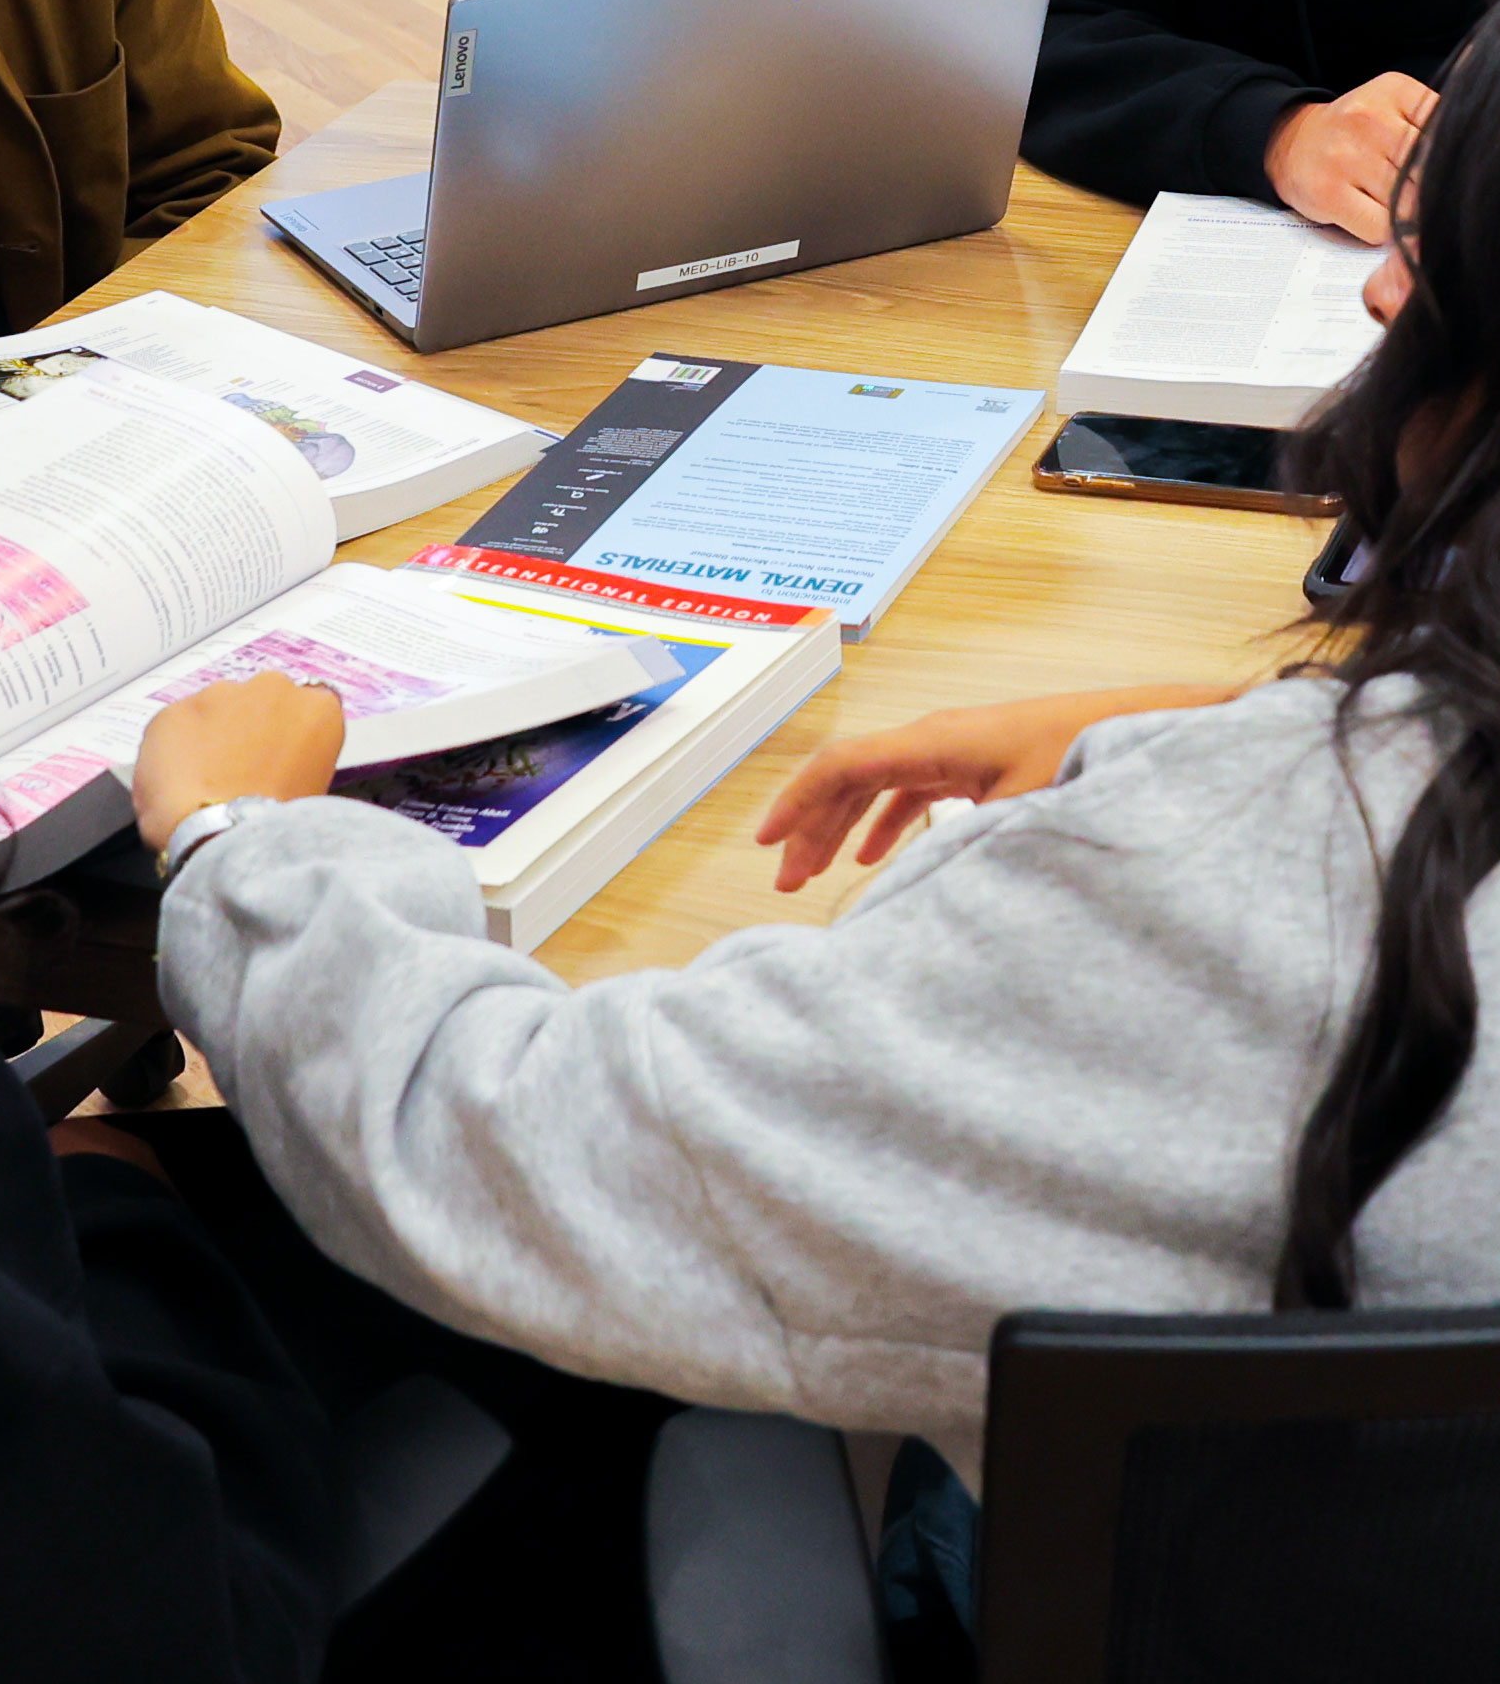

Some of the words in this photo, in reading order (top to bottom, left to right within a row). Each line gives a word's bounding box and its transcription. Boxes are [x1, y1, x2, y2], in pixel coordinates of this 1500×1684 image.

[449, 36, 469, 92] Lenovo
[678, 251, 760, 277] MED-LIB-10
[596, 552, 751, 582] MATERIALS
[443, 556, 648, 604] INTERNATIONAL
[661, 598, 772, 622] EDITION
[762, 572, 863, 596] DENTAL
